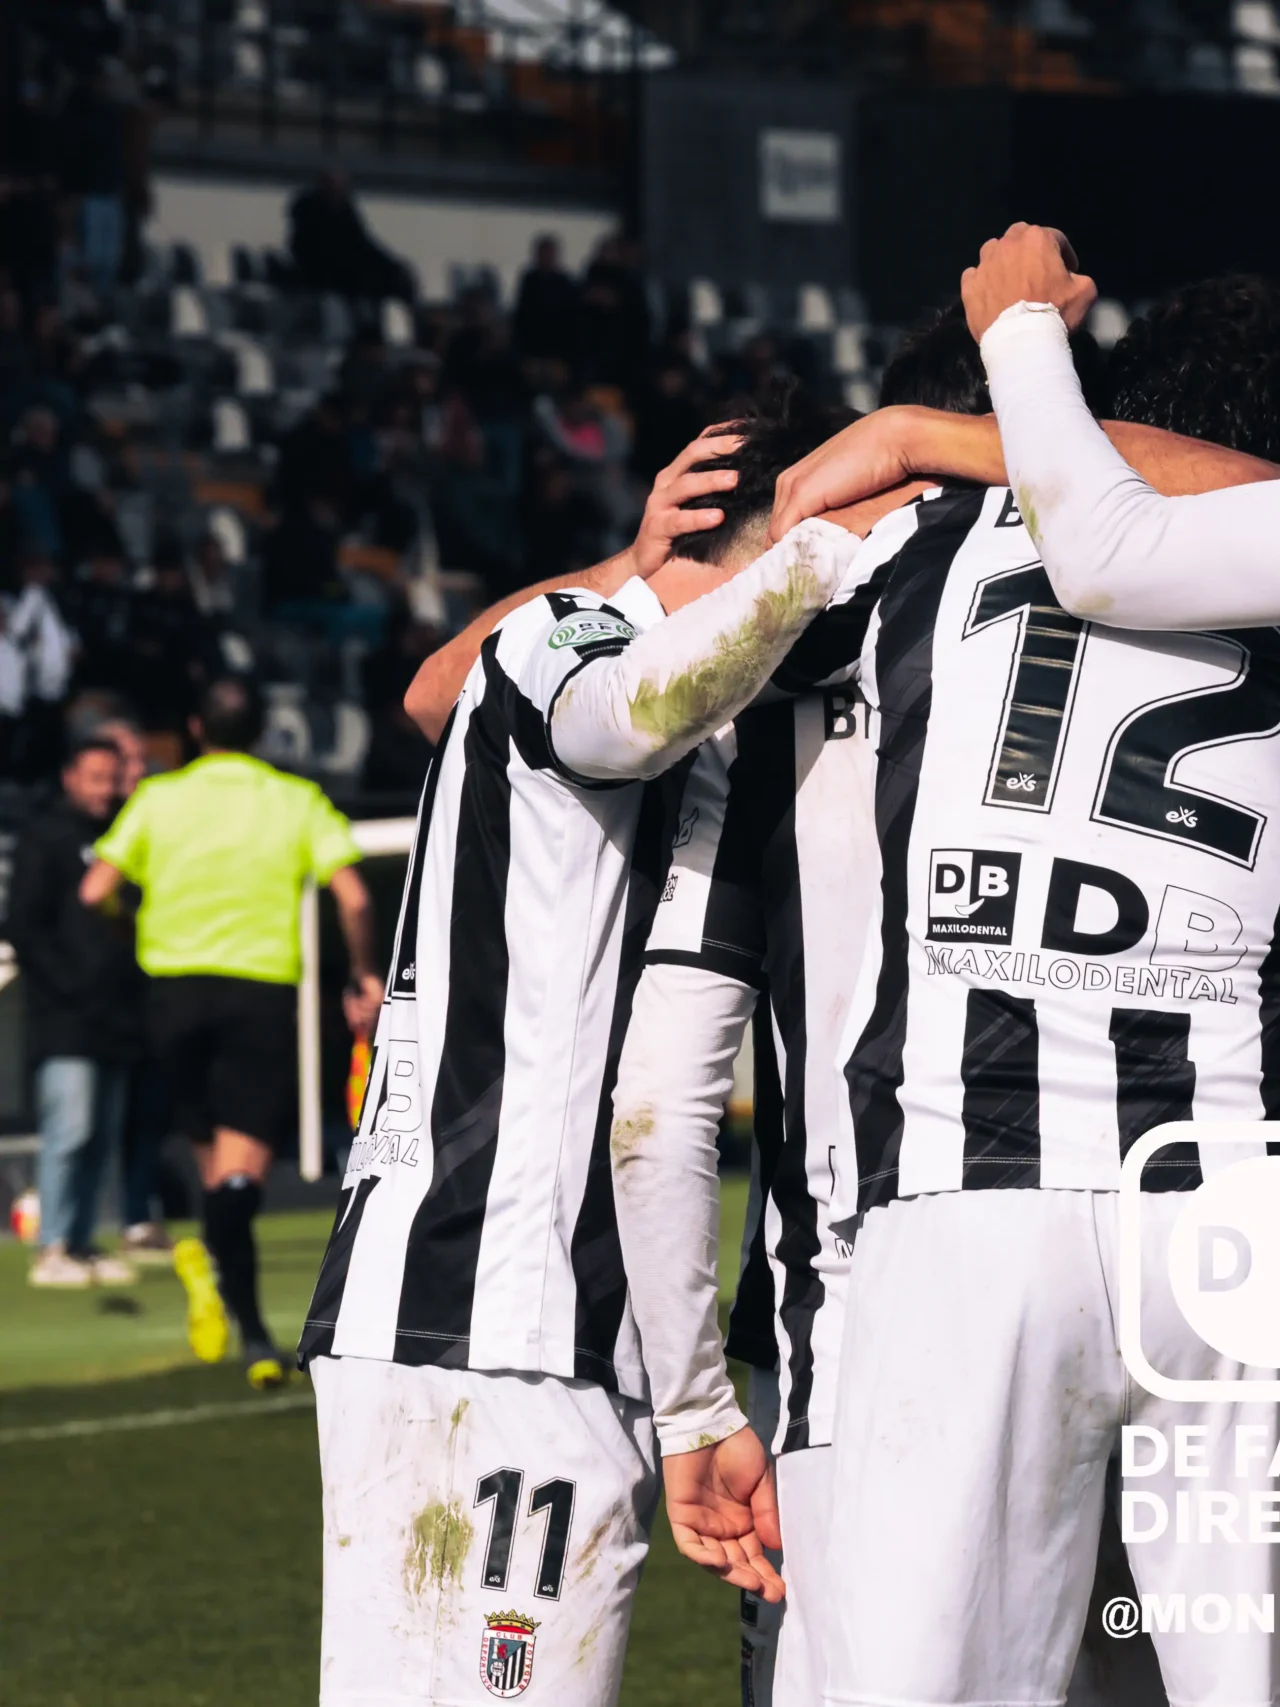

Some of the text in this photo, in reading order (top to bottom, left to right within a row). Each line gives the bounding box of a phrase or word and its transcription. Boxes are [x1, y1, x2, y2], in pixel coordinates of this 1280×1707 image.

[935, 863, 1010, 897] DB
[932, 923, 1008, 937] MAXILODENTAL
[1040, 857, 1248, 972] DB
[924, 945, 1239, 1004] MAXILODENTAL
[473, 1466, 576, 1602] 11
[496, 1632, 523, 1640] CLUB
[480, 1637, 493, 1690] DEPORTIVO
[518, 1643, 534, 1691] BADAJOZ
